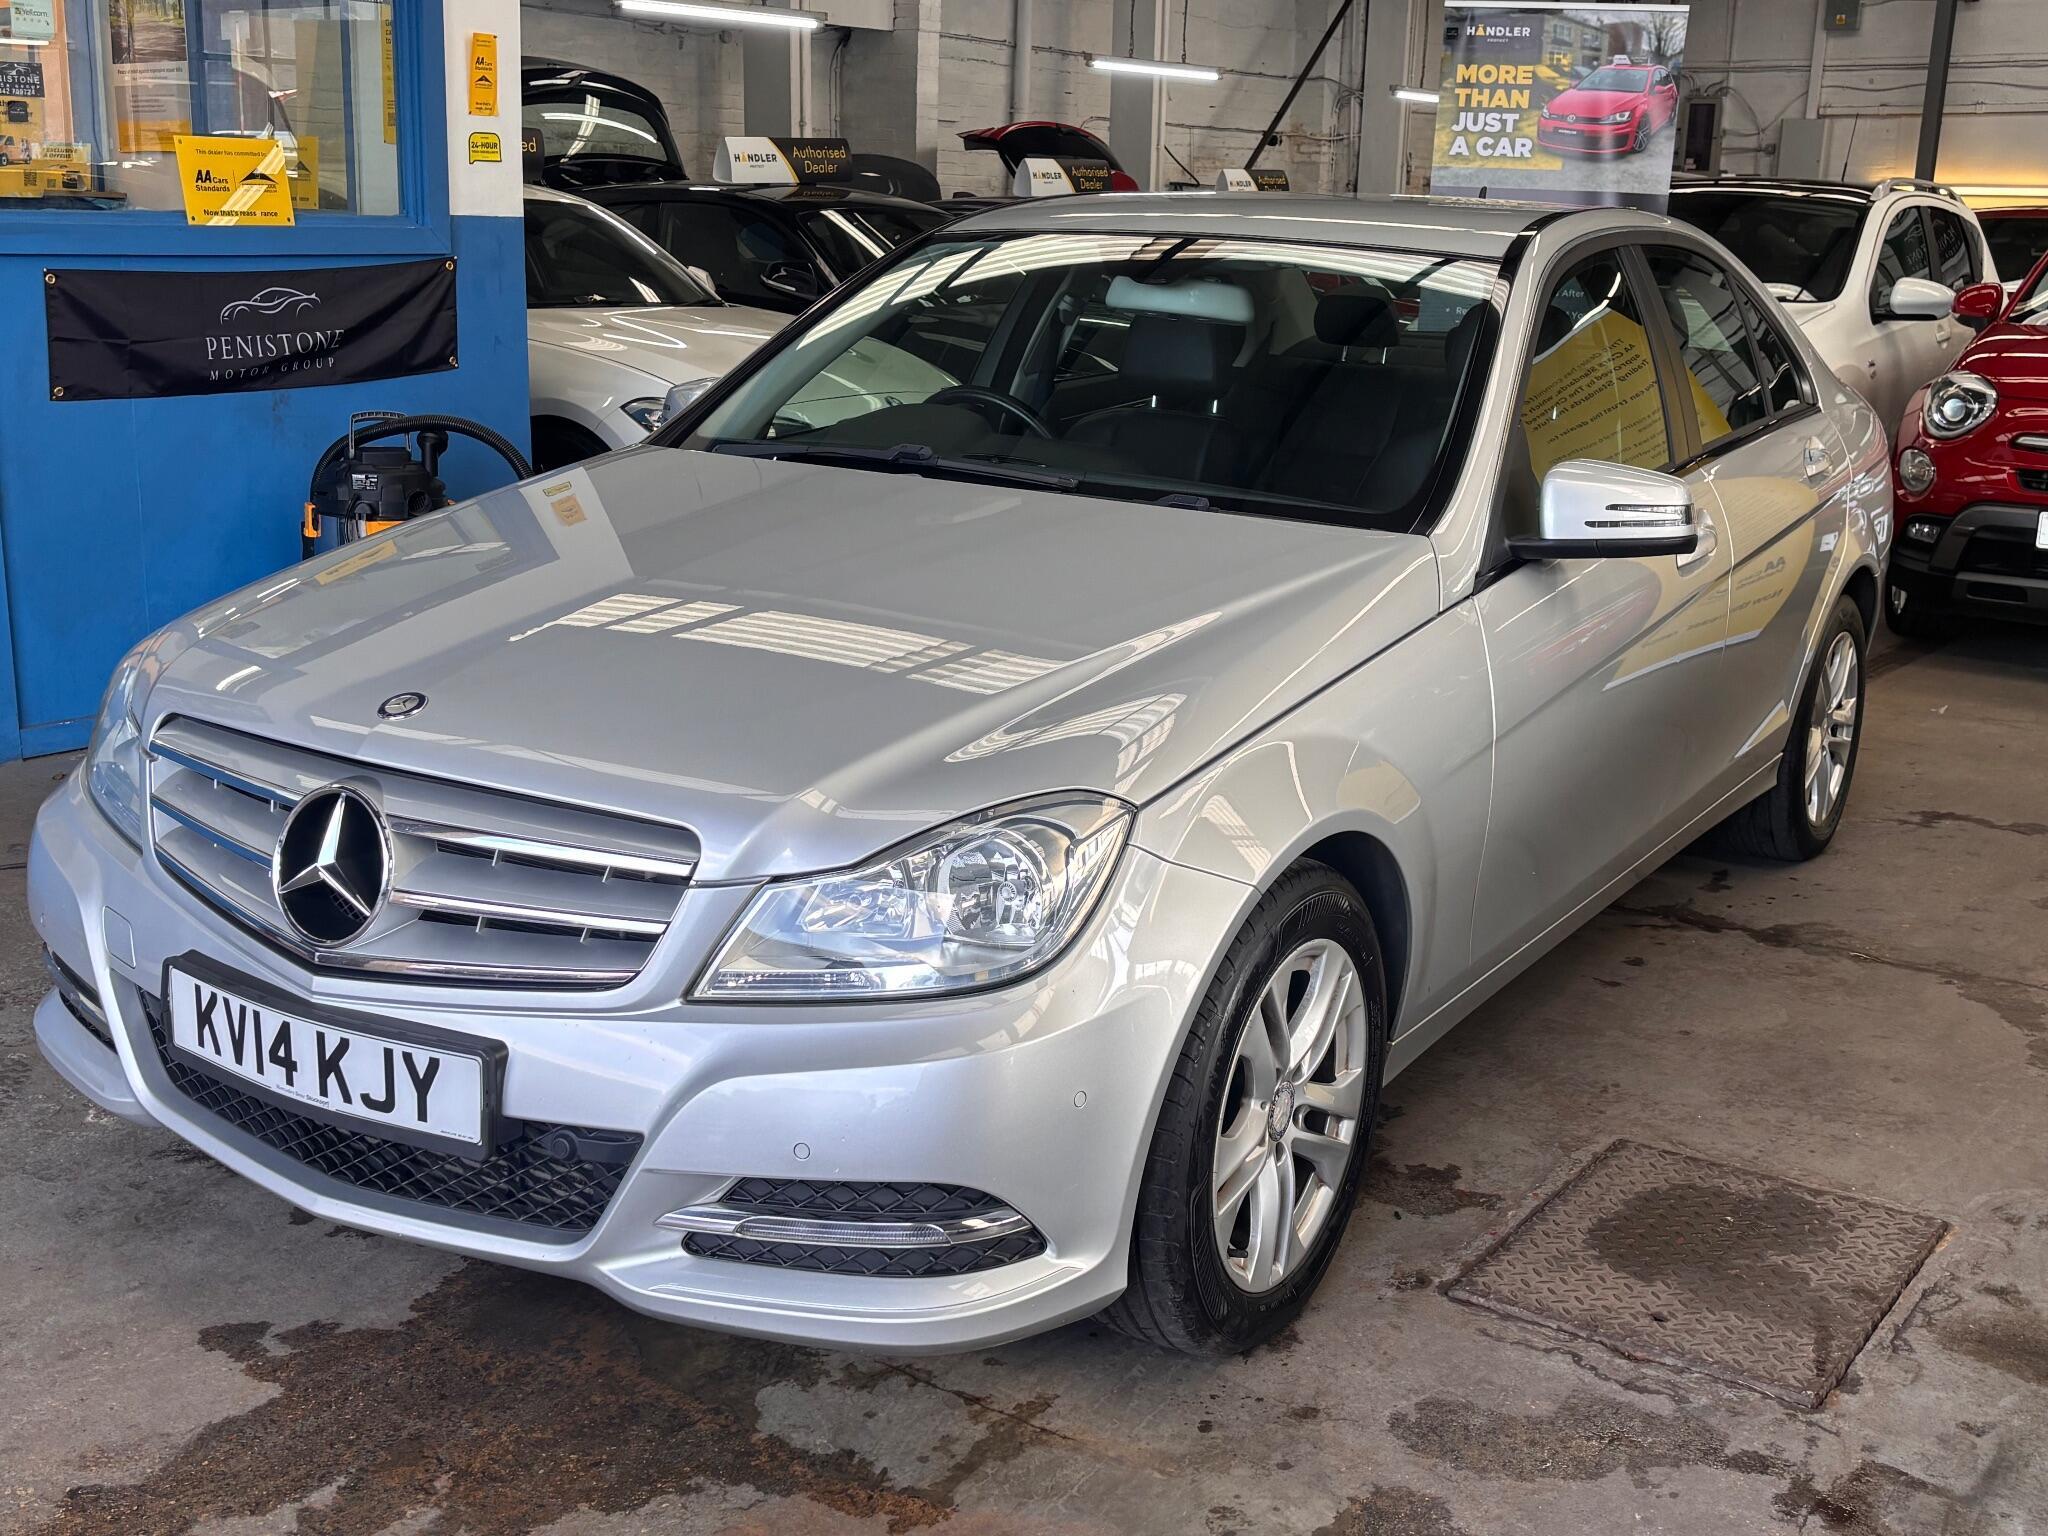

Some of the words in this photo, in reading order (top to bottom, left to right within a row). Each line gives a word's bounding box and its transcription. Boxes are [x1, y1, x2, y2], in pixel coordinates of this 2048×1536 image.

[1456, 64, 1533, 84] MORE
[1455, 88, 1530, 108] THAN
[1451, 112, 1519, 132] JUST
[471, 141, 498, 150] 24-HOUR
[793, 144, 846, 159] Authorised
[1448, 136, 1469, 156] A
[1476, 136, 1532, 157] CAR
[804, 161, 838, 174] Dealer
[1071, 165, 1109, 177] Authorised
[195, 169, 212, 184] AA
[1080, 178, 1103, 190] Dealer
[195, 184, 231, 192] Standards
[203, 208, 220, 217] Now
[220, 209, 239, 217] that's
[1562, 289, 1585, 299] After
[205, 329, 345, 360] PENISTONE
[209, 365, 270, 381] MOTOR
[281, 356, 335, 372] GROUP
[194, 983, 298, 1088] KV14
[315, 1029, 441, 1123] KJY
